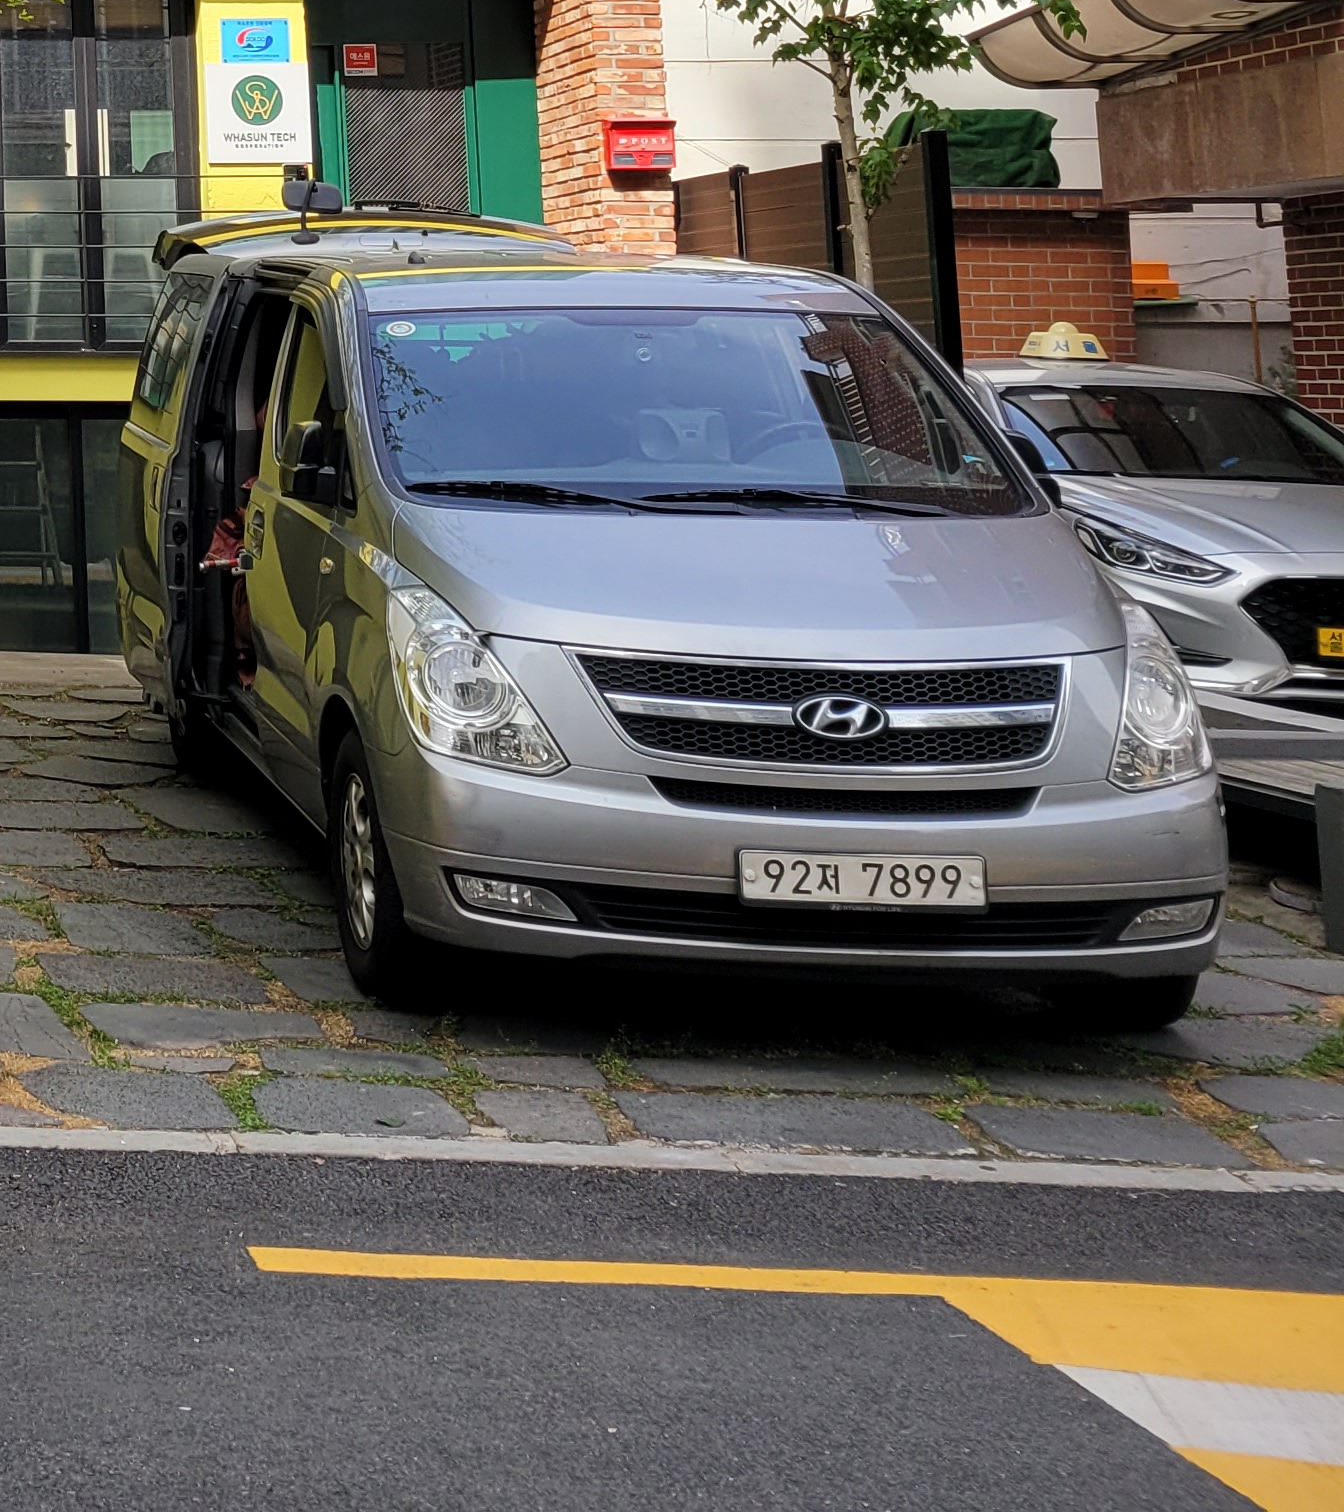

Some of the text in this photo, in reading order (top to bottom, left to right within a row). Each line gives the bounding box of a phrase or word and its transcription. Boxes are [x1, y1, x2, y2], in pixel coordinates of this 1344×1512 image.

[223, 132, 297, 143] WHASUN TECH
[631, 137, 668, 145] POST
[861, 862, 962, 899] 7899
